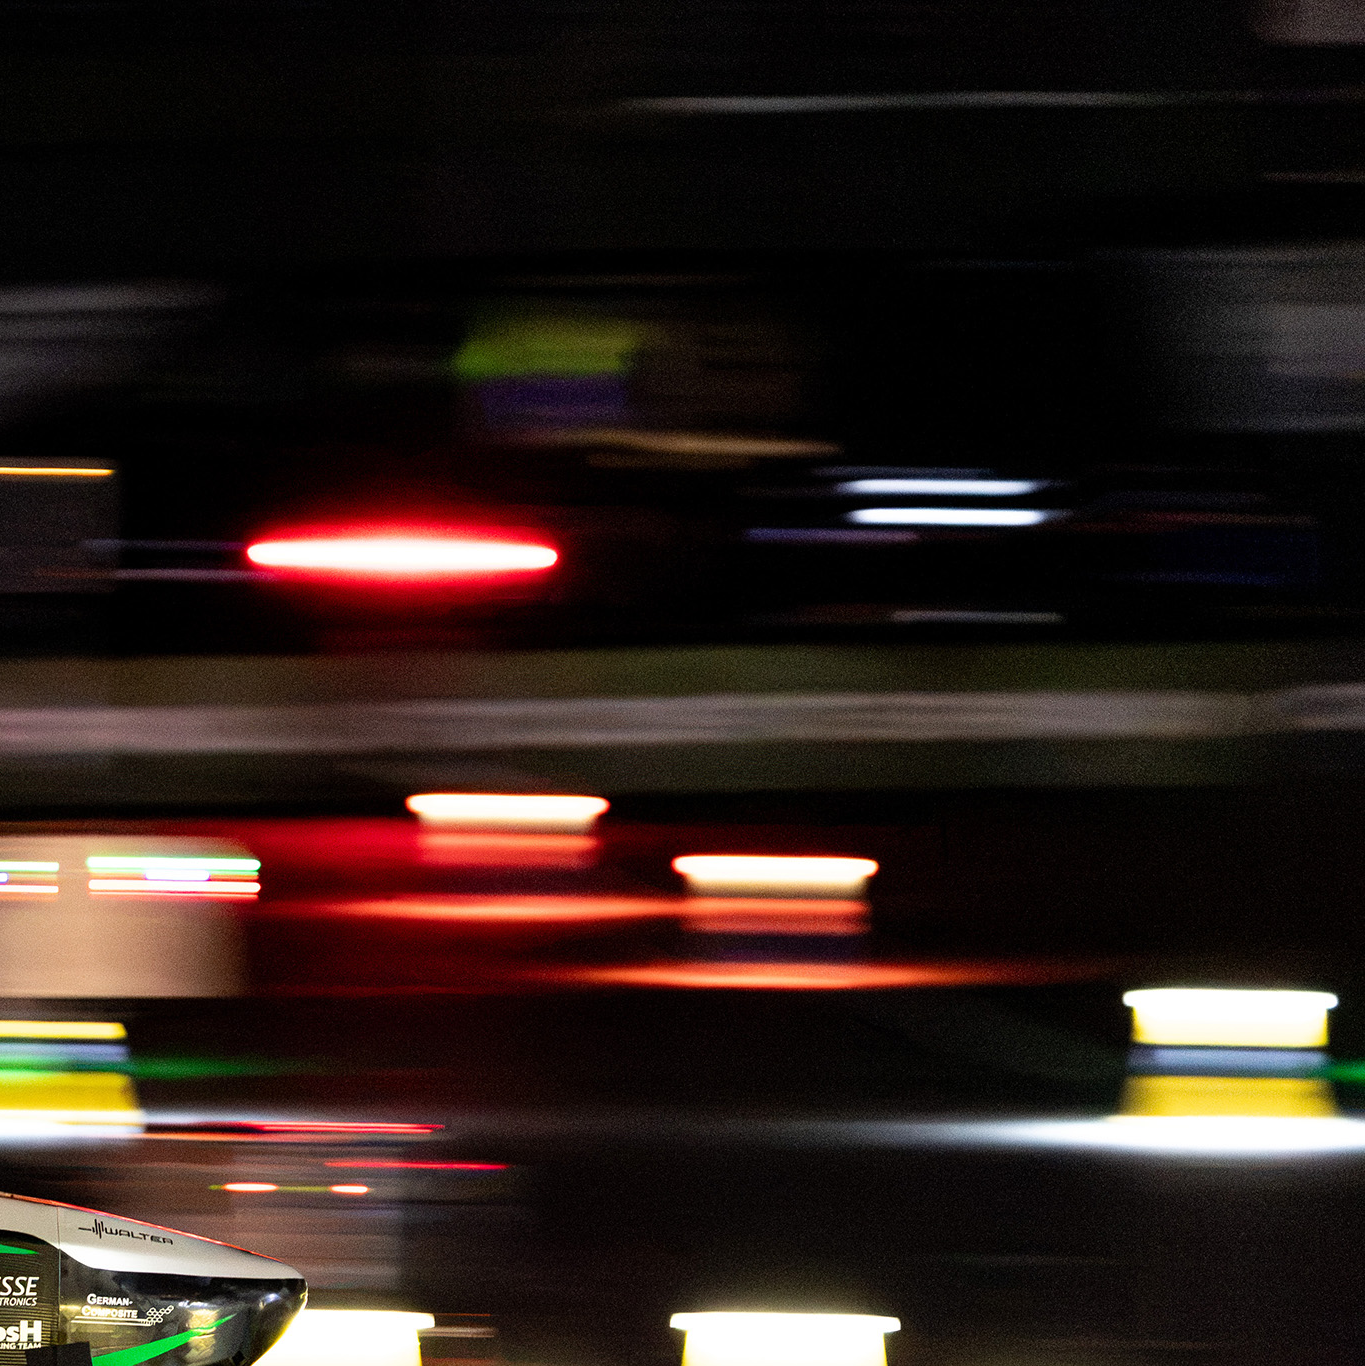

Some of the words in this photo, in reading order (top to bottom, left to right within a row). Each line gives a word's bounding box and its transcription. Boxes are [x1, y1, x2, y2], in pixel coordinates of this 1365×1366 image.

[104, 1226, 174, 1245] WALTER
[81, 1306, 138, 1319] COMPOSITE
[17, 1342, 42, 1350] TEAM
